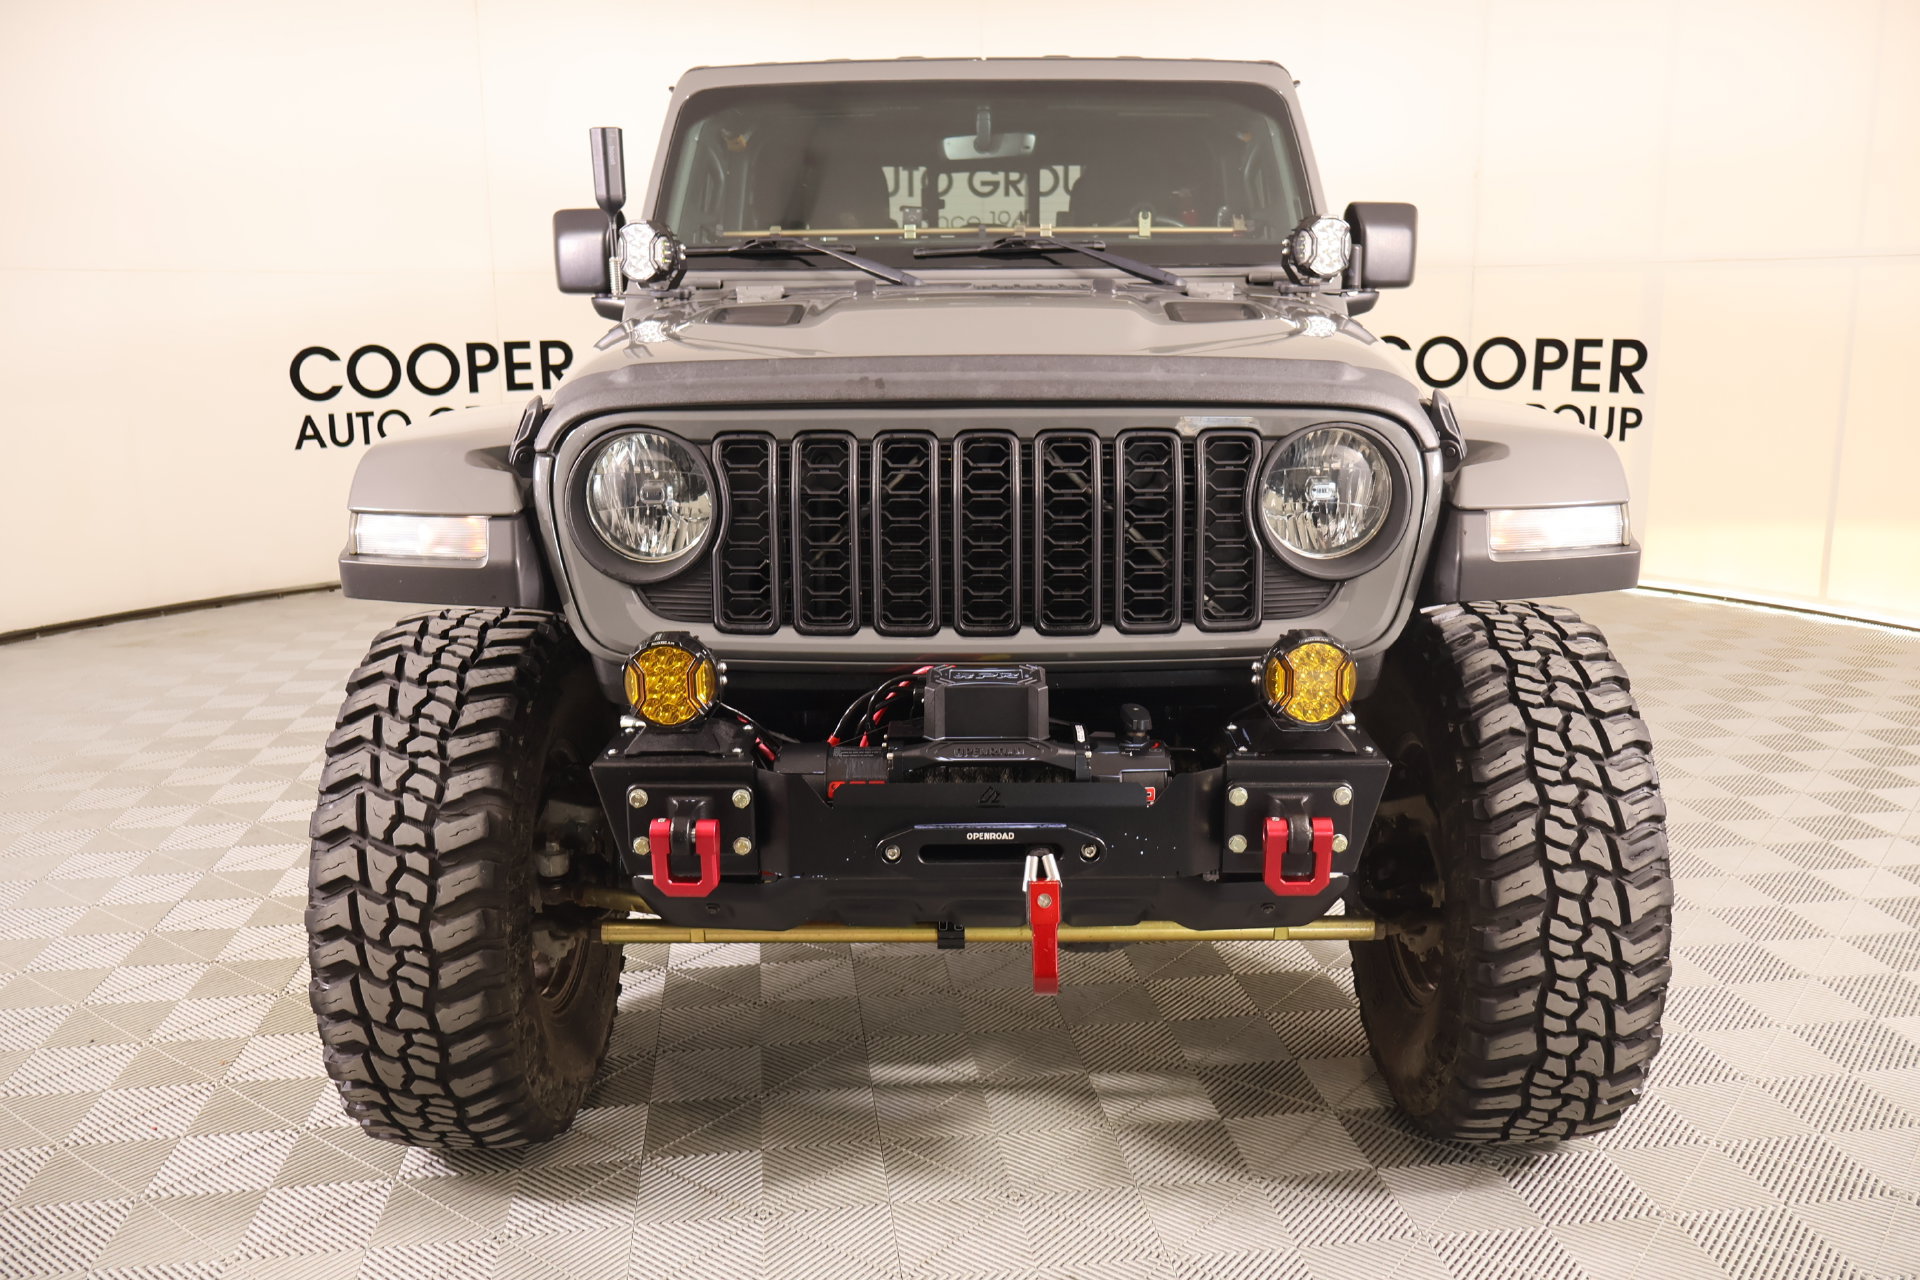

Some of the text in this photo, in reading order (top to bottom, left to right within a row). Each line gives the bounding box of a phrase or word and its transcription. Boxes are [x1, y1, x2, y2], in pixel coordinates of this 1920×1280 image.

[289, 340, 573, 401] COOPER
[1379, 336, 1648, 394] OOPER
[294, 409, 412, 450] AUTO
[966, 832, 1015, 841] OPENROAD
